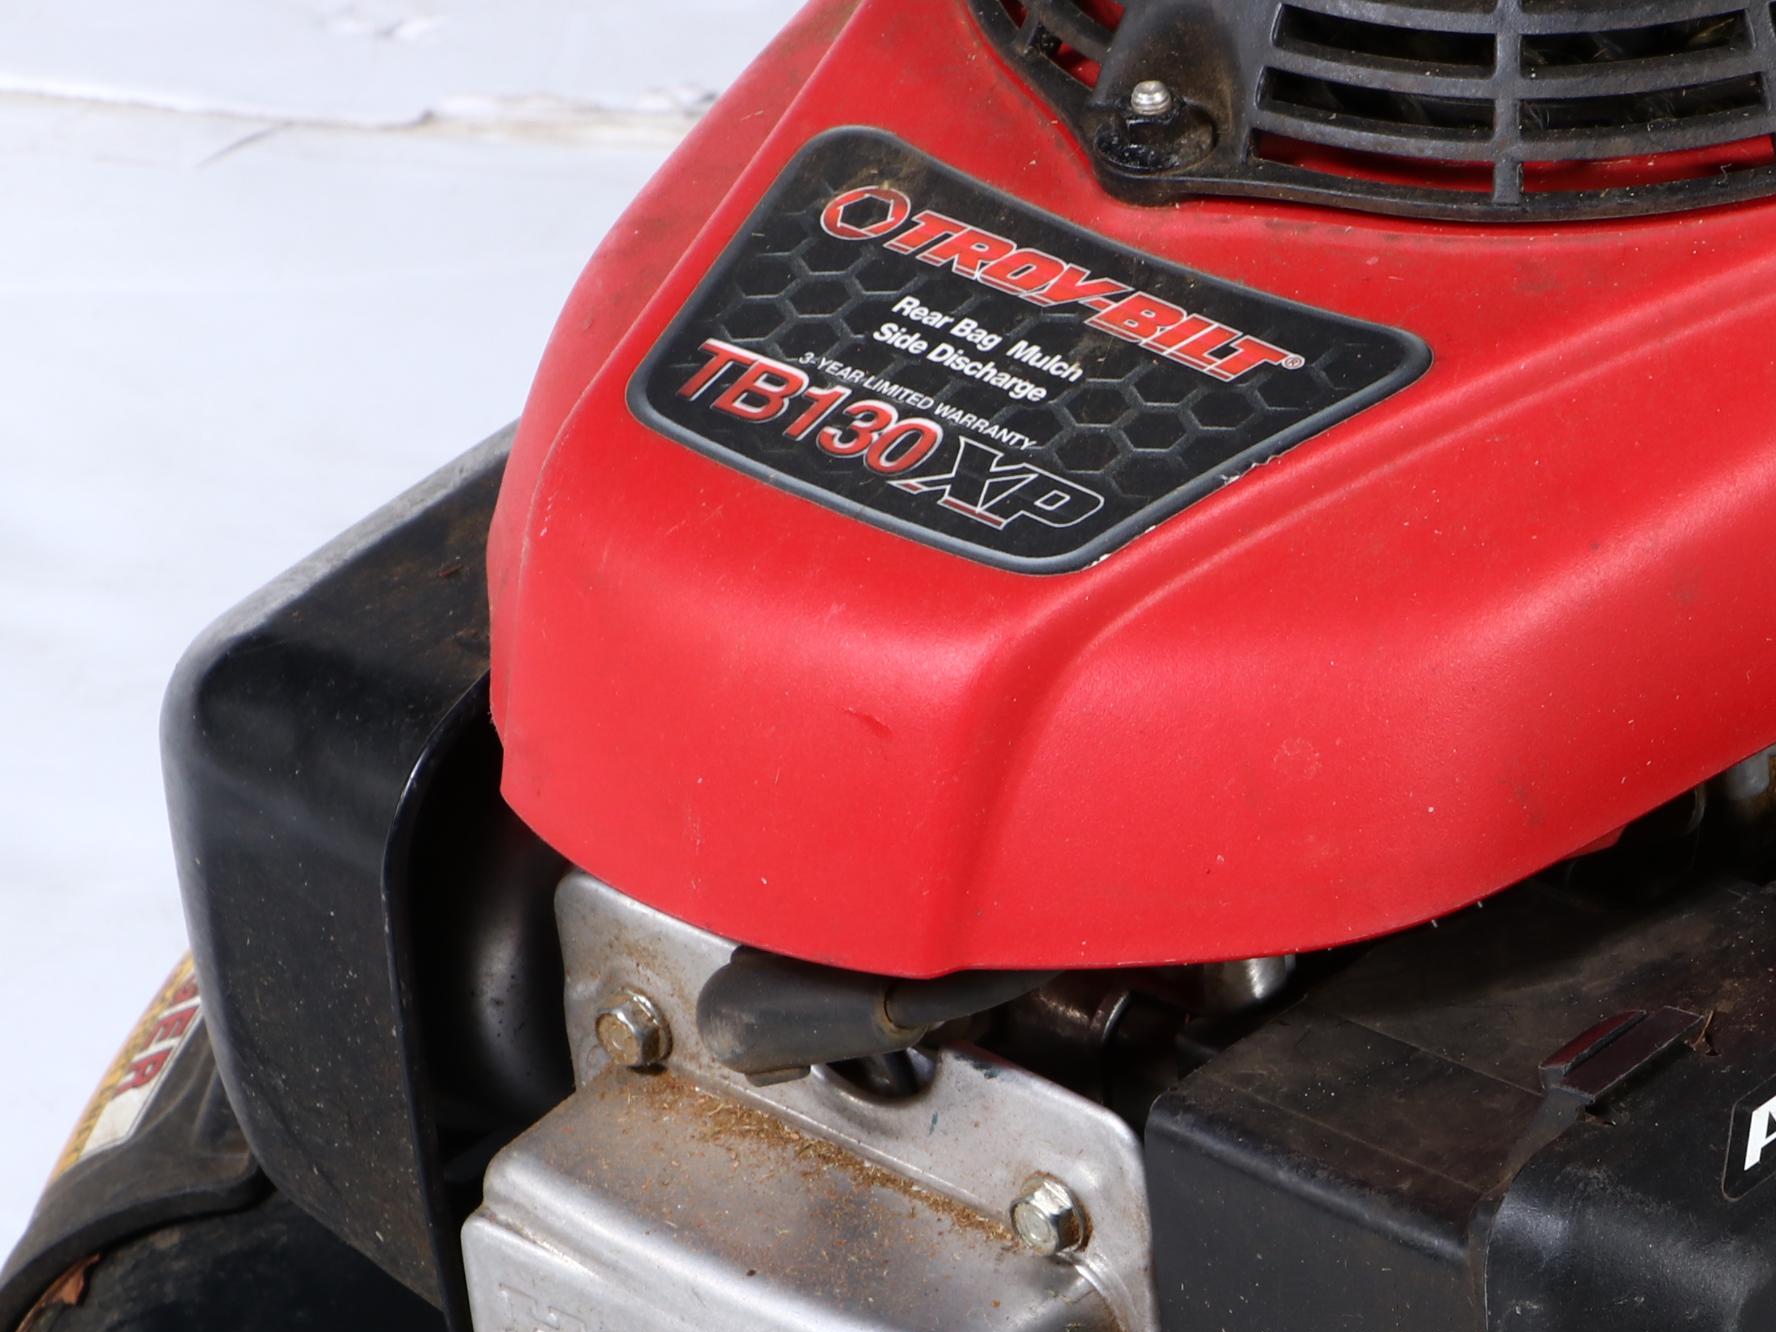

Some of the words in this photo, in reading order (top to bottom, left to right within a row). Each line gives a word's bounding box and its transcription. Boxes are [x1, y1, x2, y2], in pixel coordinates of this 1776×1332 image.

[872, 322, 928, 354] Side
[926, 342, 1047, 402] Discharge
[891, 296, 954, 329] Rear
[950, 317, 1002, 352] Bag
[1006, 339, 1084, 382] Mulch
[864, 375, 935, 410] LIMITED
[934, 402, 1039, 450] WARRANTY
